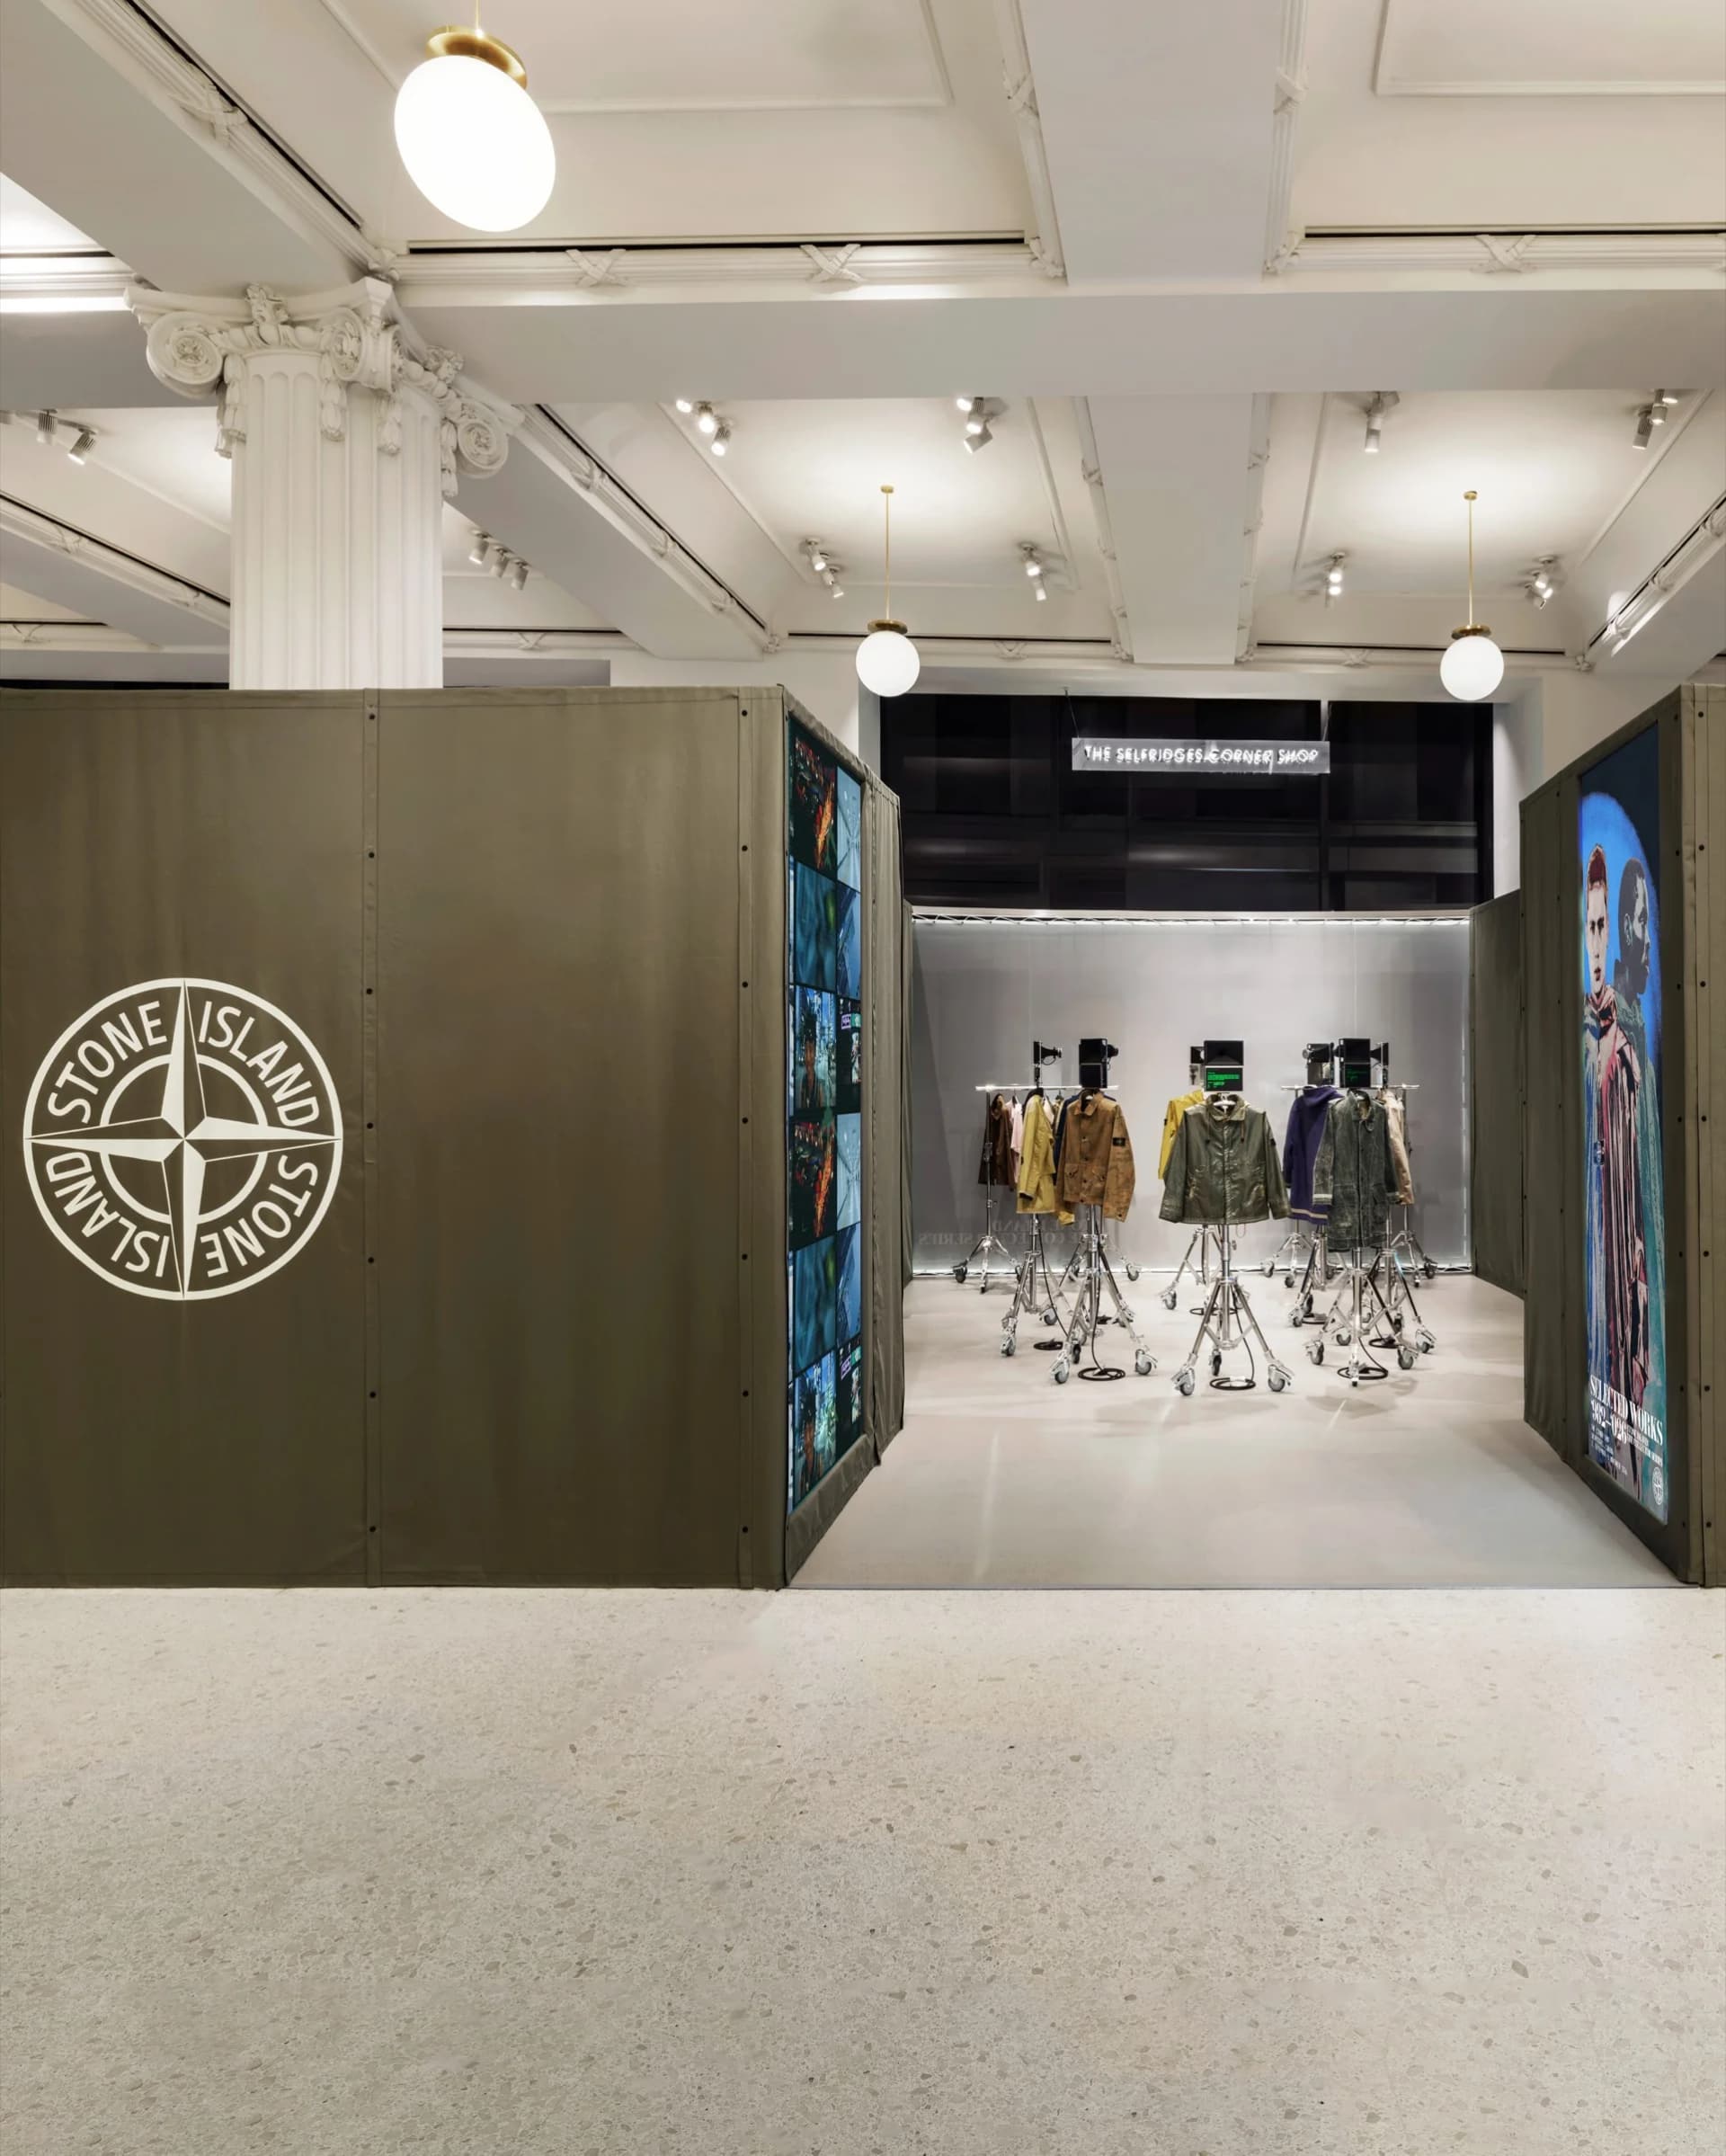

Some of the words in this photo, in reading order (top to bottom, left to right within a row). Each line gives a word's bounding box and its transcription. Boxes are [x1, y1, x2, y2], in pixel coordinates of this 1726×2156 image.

[1084, 744, 1111, 762] THE
[1116, 747, 1203, 763] SELFRIDGES
[1208, 748, 1274, 764] CORNER
[1277, 748, 1319, 764] SHOP
[47, 1000, 167, 1125] STONE
[198, 1000, 320, 1127] ISLAND
[45, 1151, 170, 1278] ISLAND
[200, 1154, 318, 1278] STONE
[1589, 1374, 1629, 1422] SELECTED
[1629, 1400, 1663, 1447] WORKS
